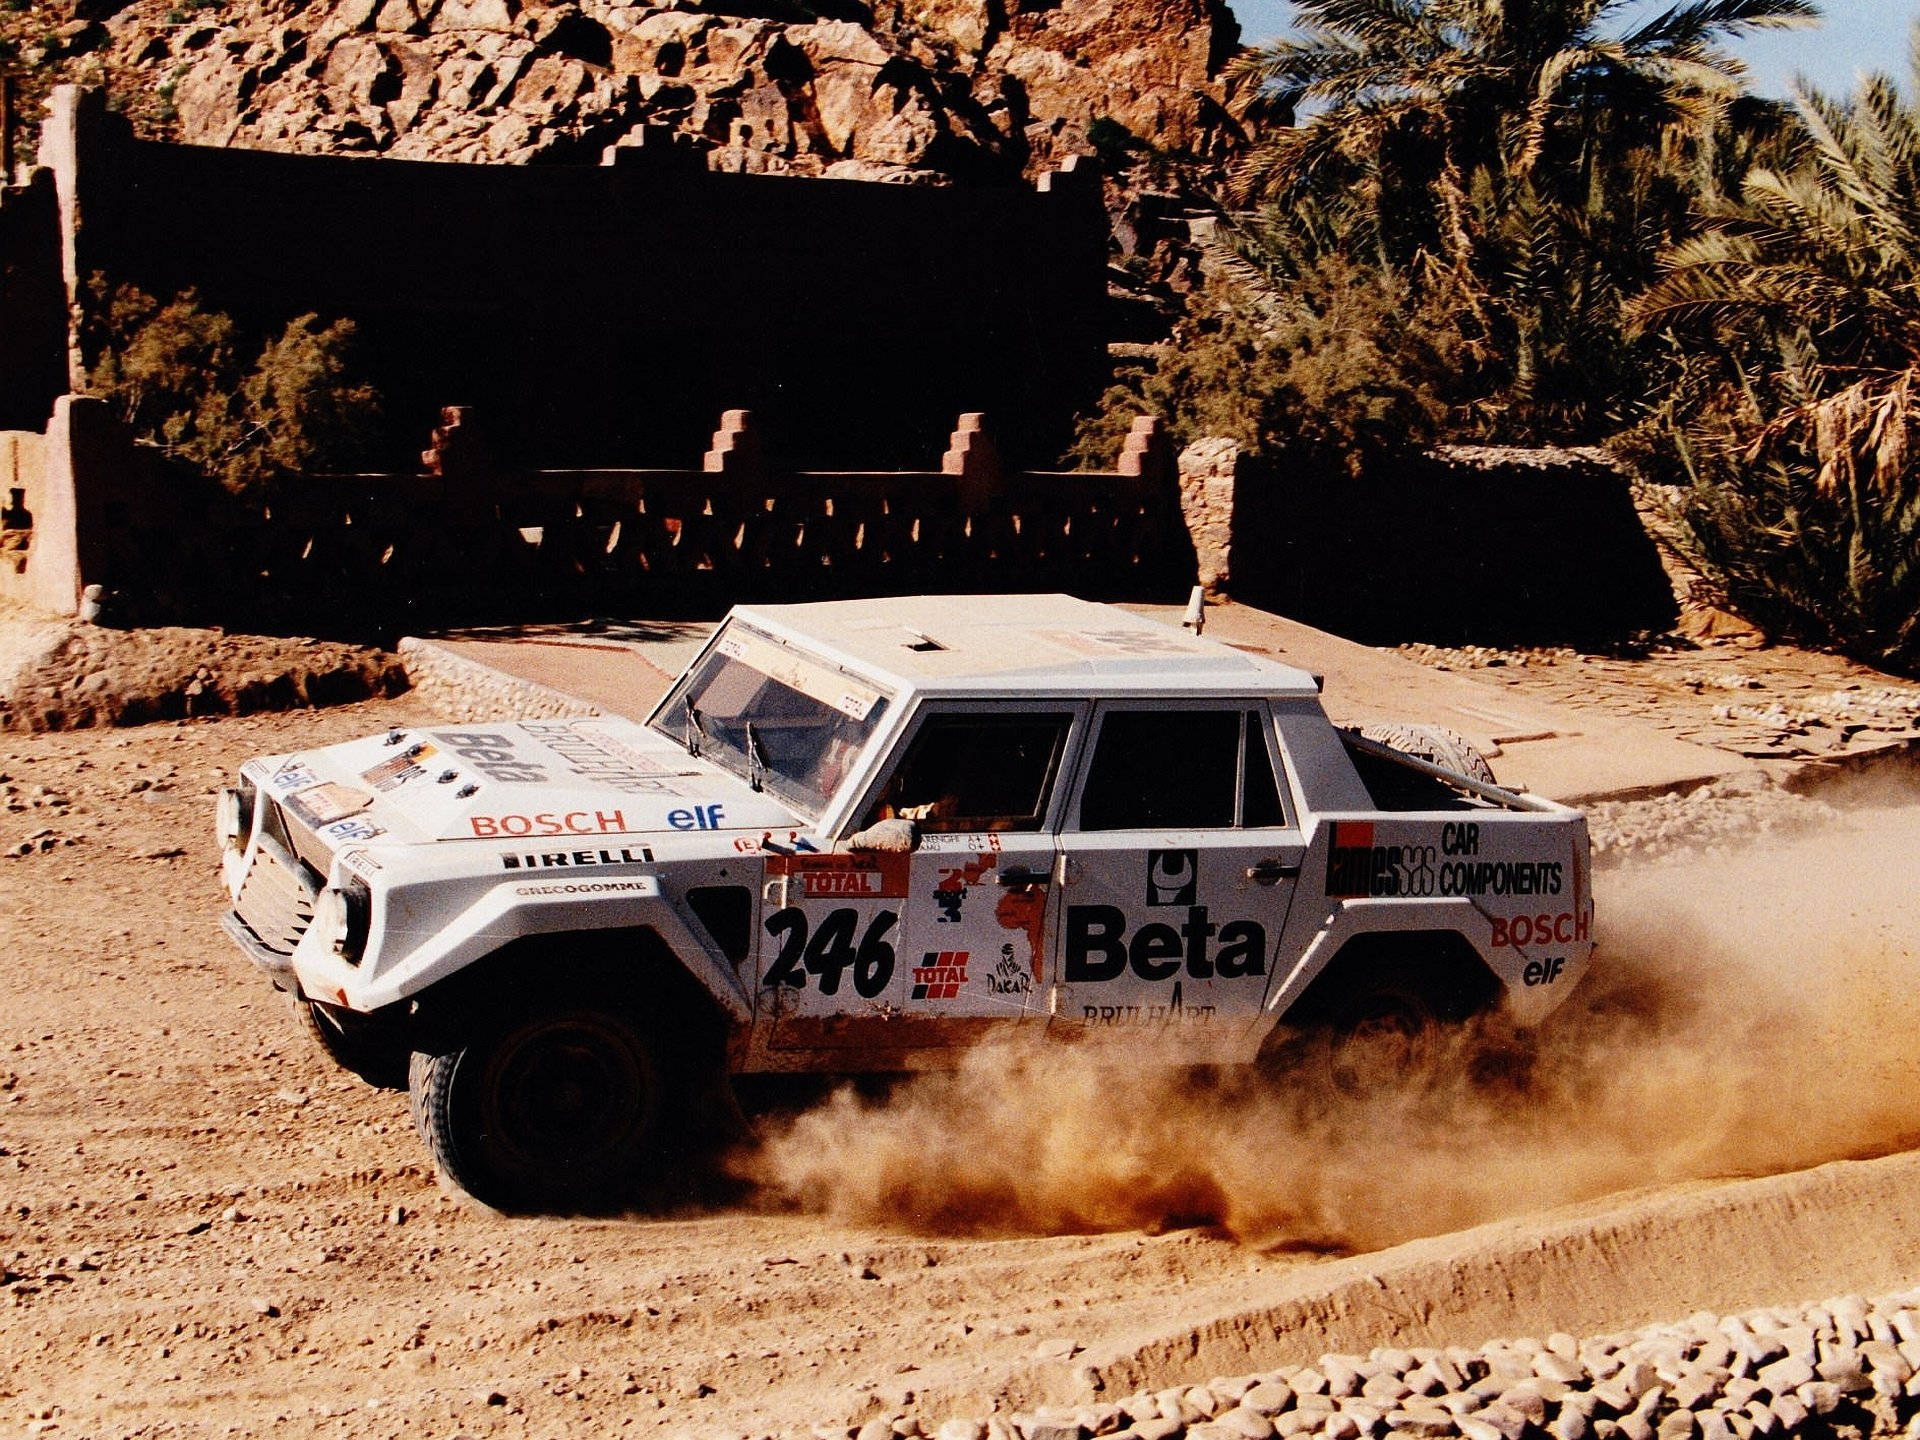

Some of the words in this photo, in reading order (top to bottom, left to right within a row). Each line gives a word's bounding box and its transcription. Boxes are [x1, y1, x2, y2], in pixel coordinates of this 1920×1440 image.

[432, 731, 549, 783] Beta
[470, 809, 627, 837] BOSCH
[667, 804, 725, 831] elf
[1441, 821, 1480, 856] CAR
[803, 872, 873, 893] TOTAL
[1439, 861, 1562, 896] COMPONENTS
[1065, 905, 1266, 982] Beta
[1491, 911, 1589, 948] BOSCH
[763, 907, 899, 999] 246
[912, 966, 969, 984] TOTAL
[987, 972, 1032, 996] DAKAR
[1523, 957, 1565, 987] elf
